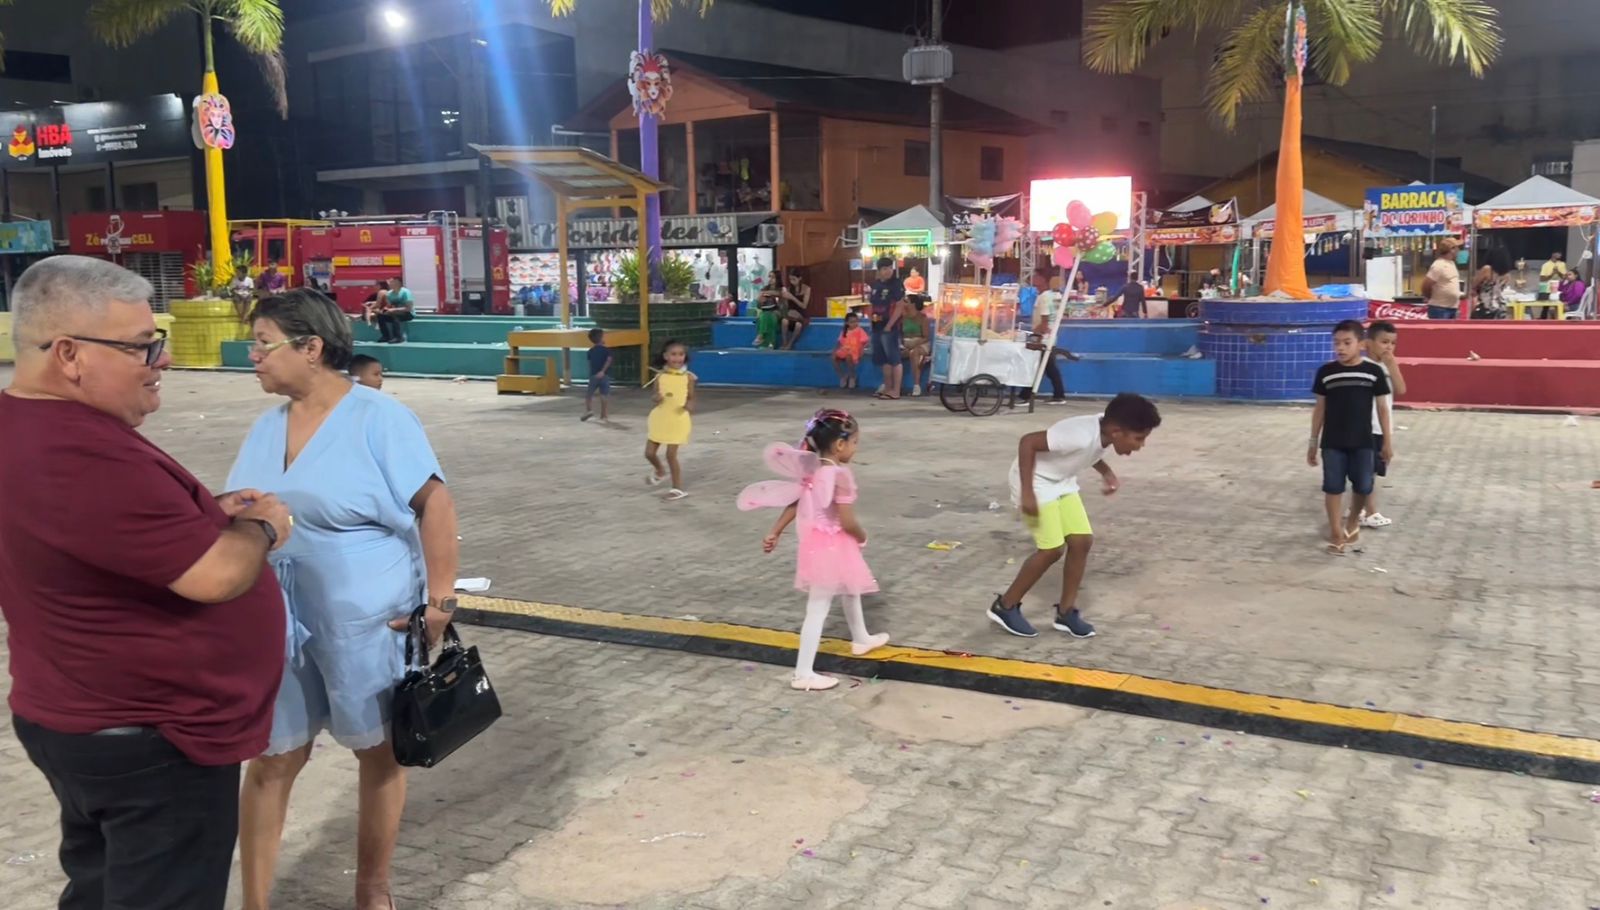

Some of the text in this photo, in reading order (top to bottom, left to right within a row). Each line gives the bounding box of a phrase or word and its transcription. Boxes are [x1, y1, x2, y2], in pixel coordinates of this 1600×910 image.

[37, 124, 73, 146] HBA
[1381, 191, 1446, 209] BARRACA
[1492, 214, 1555, 222] AMSTEL
